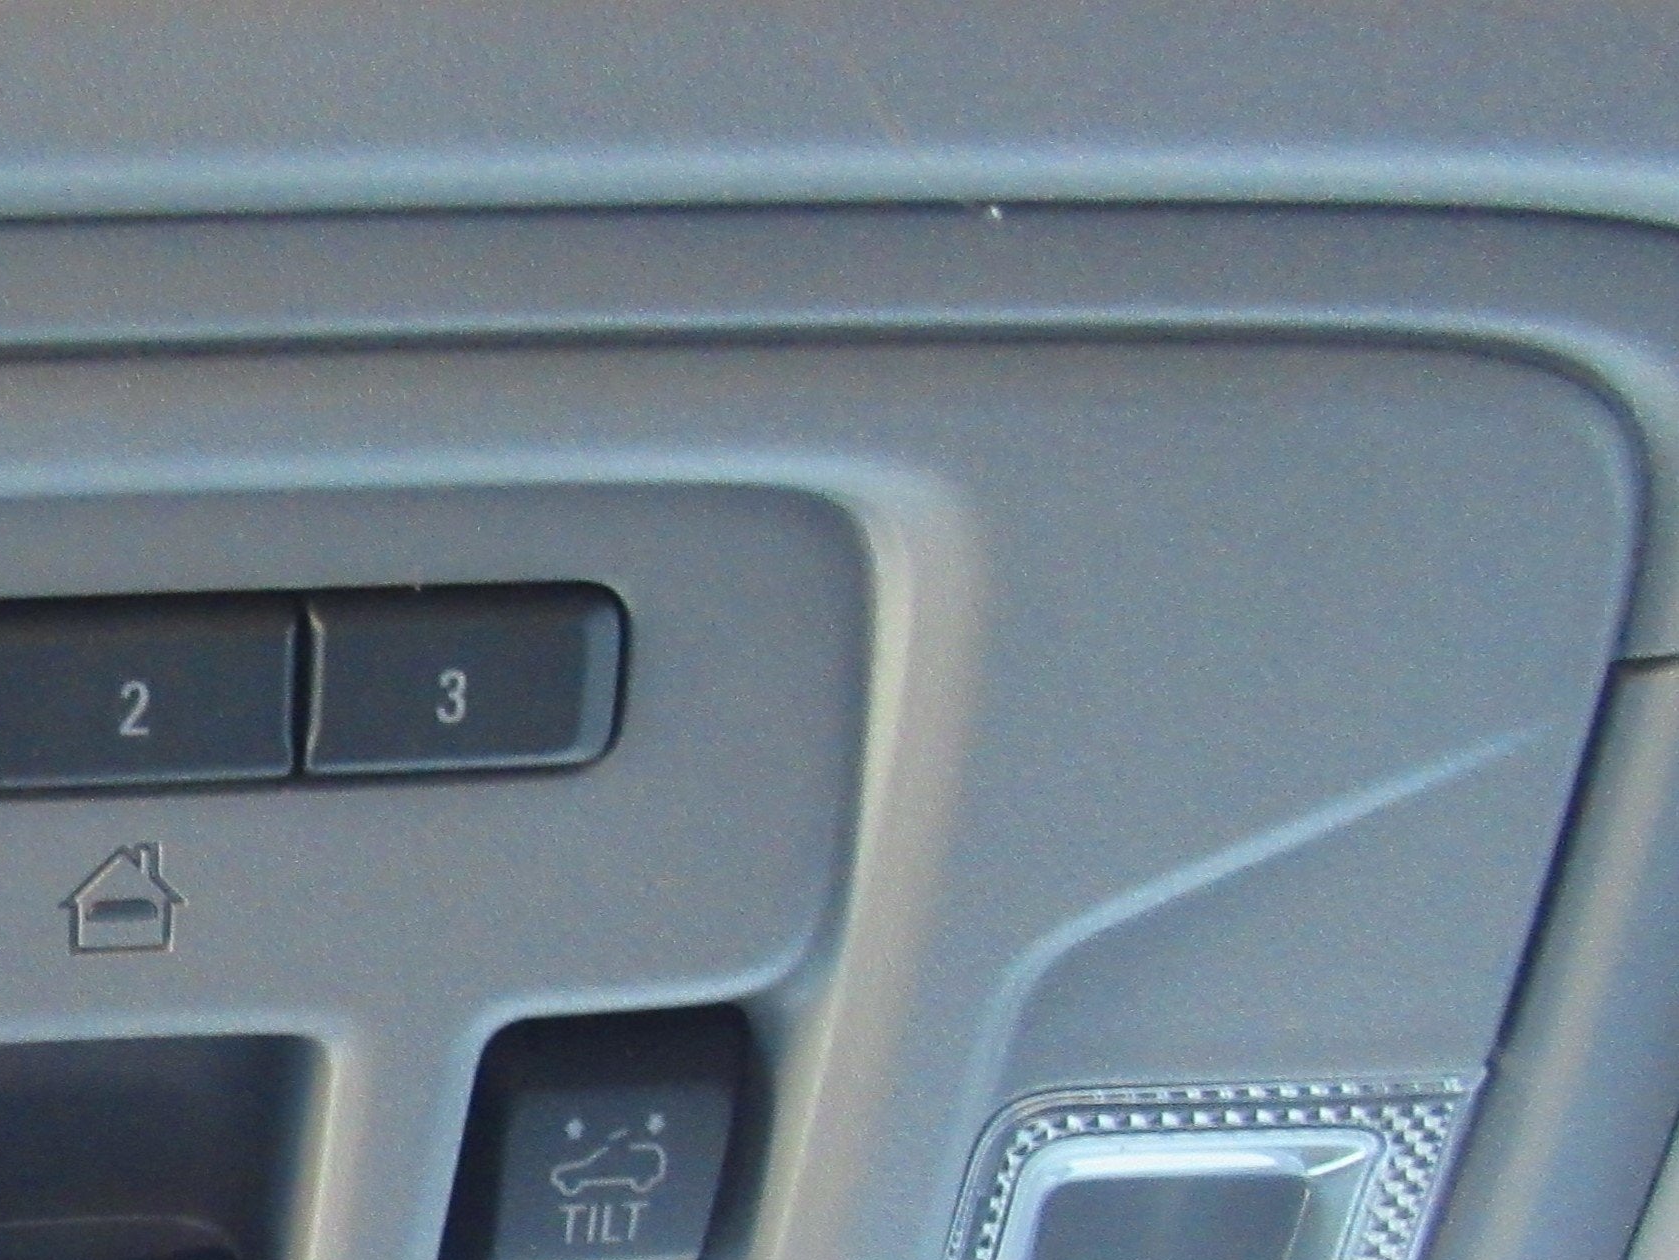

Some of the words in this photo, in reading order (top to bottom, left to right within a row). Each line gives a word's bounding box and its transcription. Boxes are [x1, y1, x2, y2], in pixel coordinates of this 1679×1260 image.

[119, 680, 151, 738] 2
[435, 668, 469, 725] 3
[558, 1201, 649, 1244] TILT
